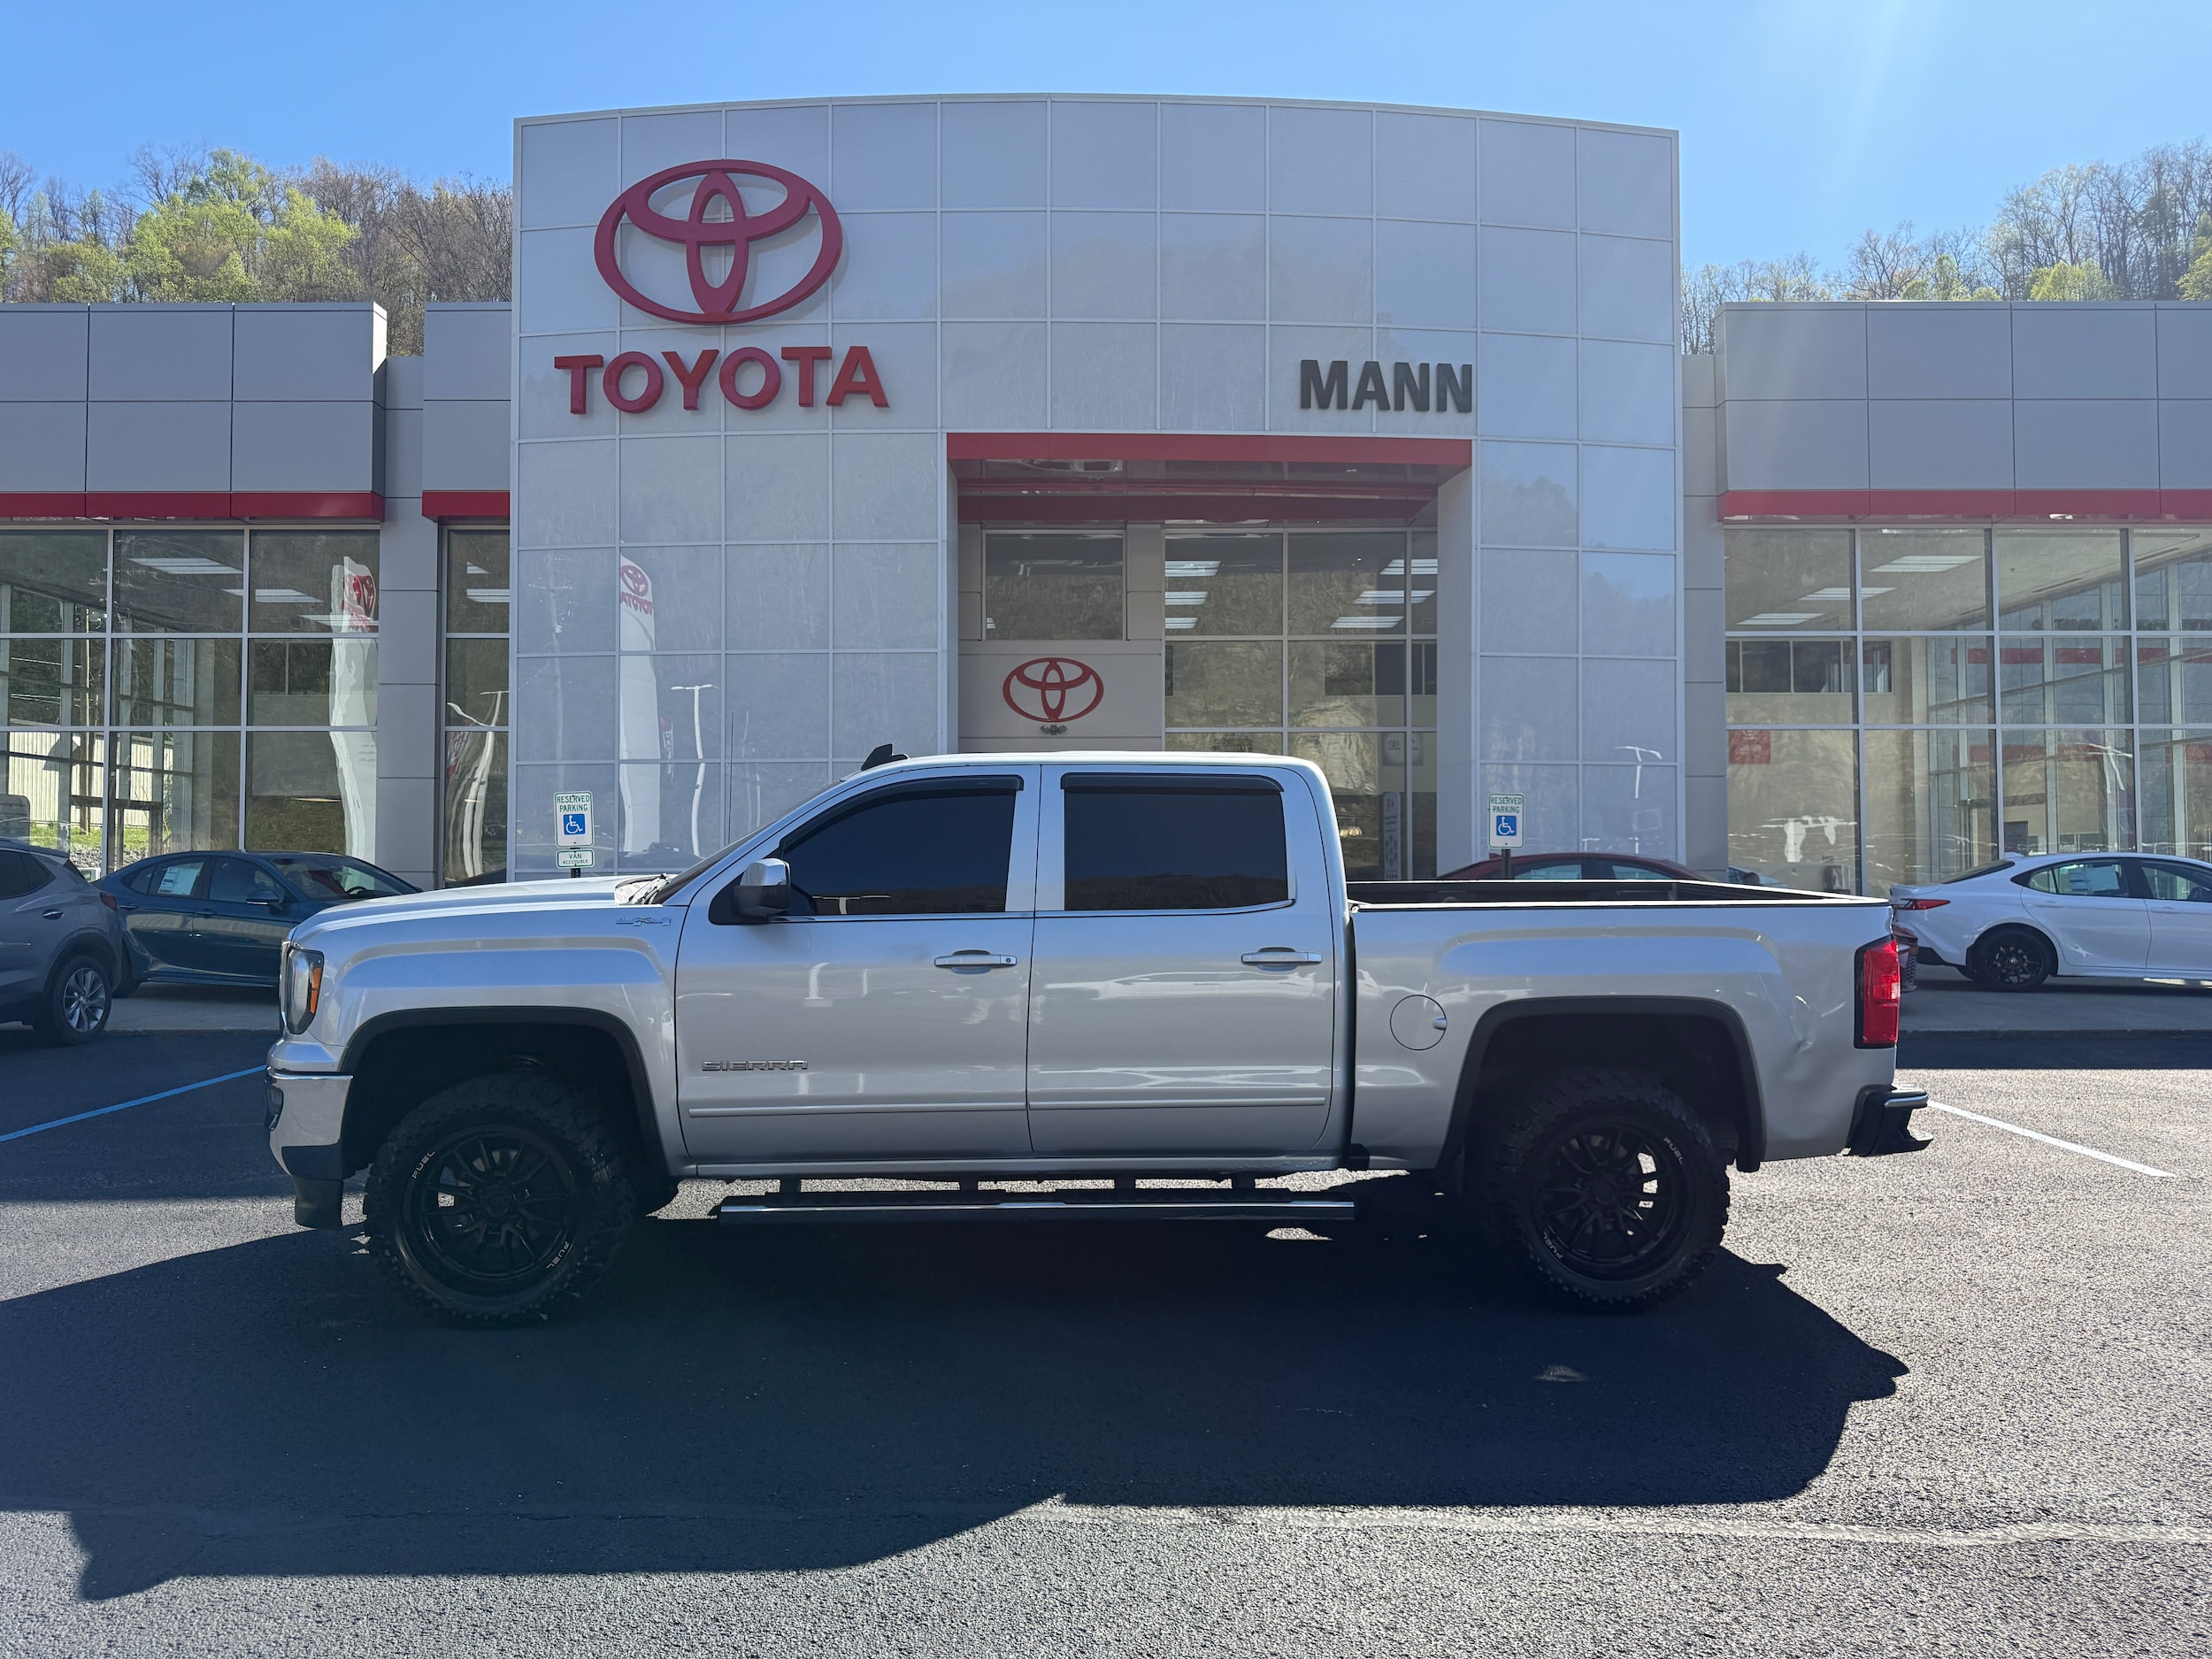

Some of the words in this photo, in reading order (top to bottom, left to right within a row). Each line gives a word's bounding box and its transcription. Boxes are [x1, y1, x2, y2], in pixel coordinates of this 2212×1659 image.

[554, 346, 890, 414] TOYOTA
[1300, 359, 1472, 412] MANN
[557, 795, 590, 803] RESERVED
[559, 803, 588, 812] PARKING
[702, 1060, 808, 1071] SIERRA
[411, 1150, 436, 1179] FUEL
[1663, 1137, 1683, 1165] FUEL
[545, 1240, 570, 1270] FUEL
[1542, 1231, 1563, 1260] FUEL
